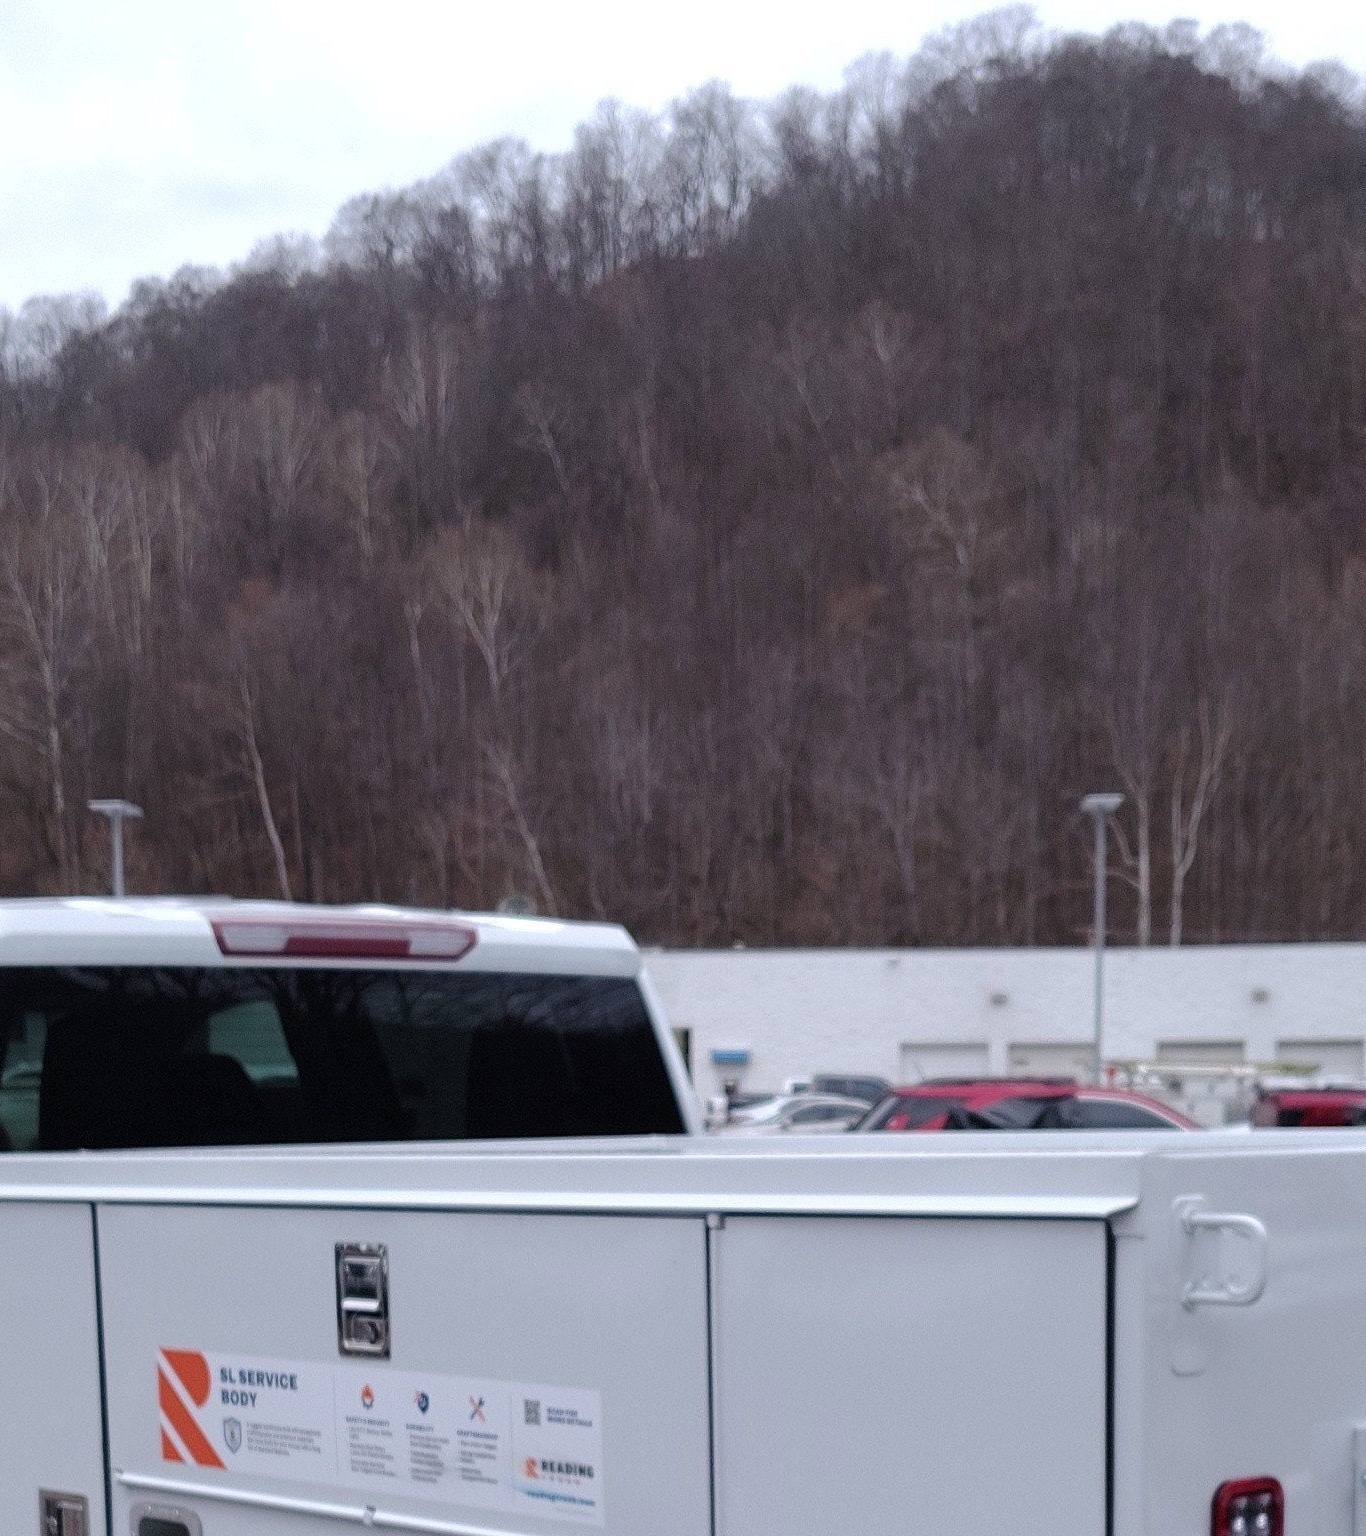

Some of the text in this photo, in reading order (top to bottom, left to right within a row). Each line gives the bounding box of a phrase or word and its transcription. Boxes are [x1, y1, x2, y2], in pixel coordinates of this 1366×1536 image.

[220, 1366, 298, 1390] SL SERVICE
[221, 1388, 258, 1407] BODY
[540, 1458, 594, 1479] READING
